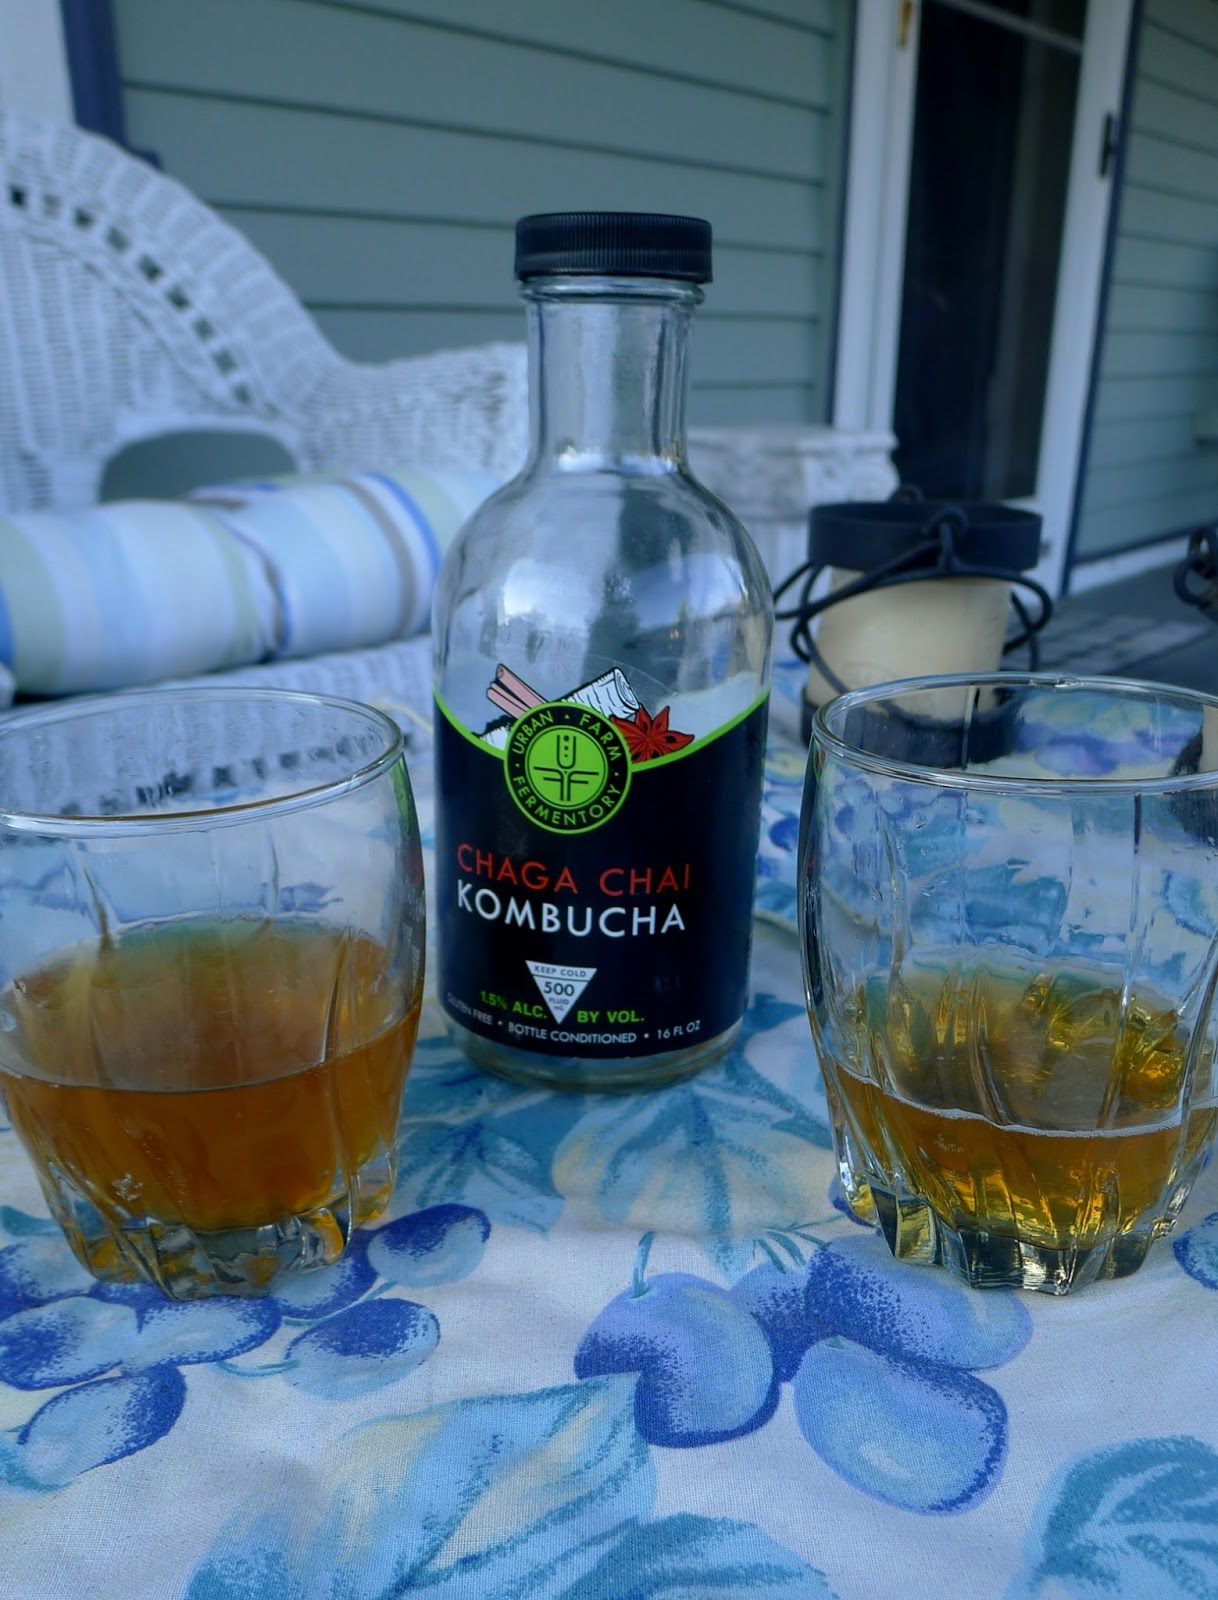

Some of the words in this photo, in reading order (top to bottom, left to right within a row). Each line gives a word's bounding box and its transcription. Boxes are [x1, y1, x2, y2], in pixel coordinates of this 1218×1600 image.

[512, 711, 554, 755] URBAN
[580, 713, 622, 761] FARM
[513, 775, 621, 826] FERMENTORY
[457, 843, 579, 895] CHAGA
[599, 863, 690, 897] CHAI
[457, 878, 686, 938] KOMBUCHA
[533, 965, 557, 975] KEEP
[560, 968, 587, 978] COLD
[543, 981, 575, 997] 500
[472, 1008, 494, 1026] FREE
[508, 1021, 548, 1040] BOTTLE
[550, 1030, 637, 1044] CONDITIONED
[657, 1028, 671, 1039] 16
[673, 1025, 684, 1036] FL
[686, 1020, 701, 1033] OZ
[512, 1000, 548, 1019] ALC.
[576, 1010, 600, 1023] BY
[606, 1010, 645, 1023] VOL.
